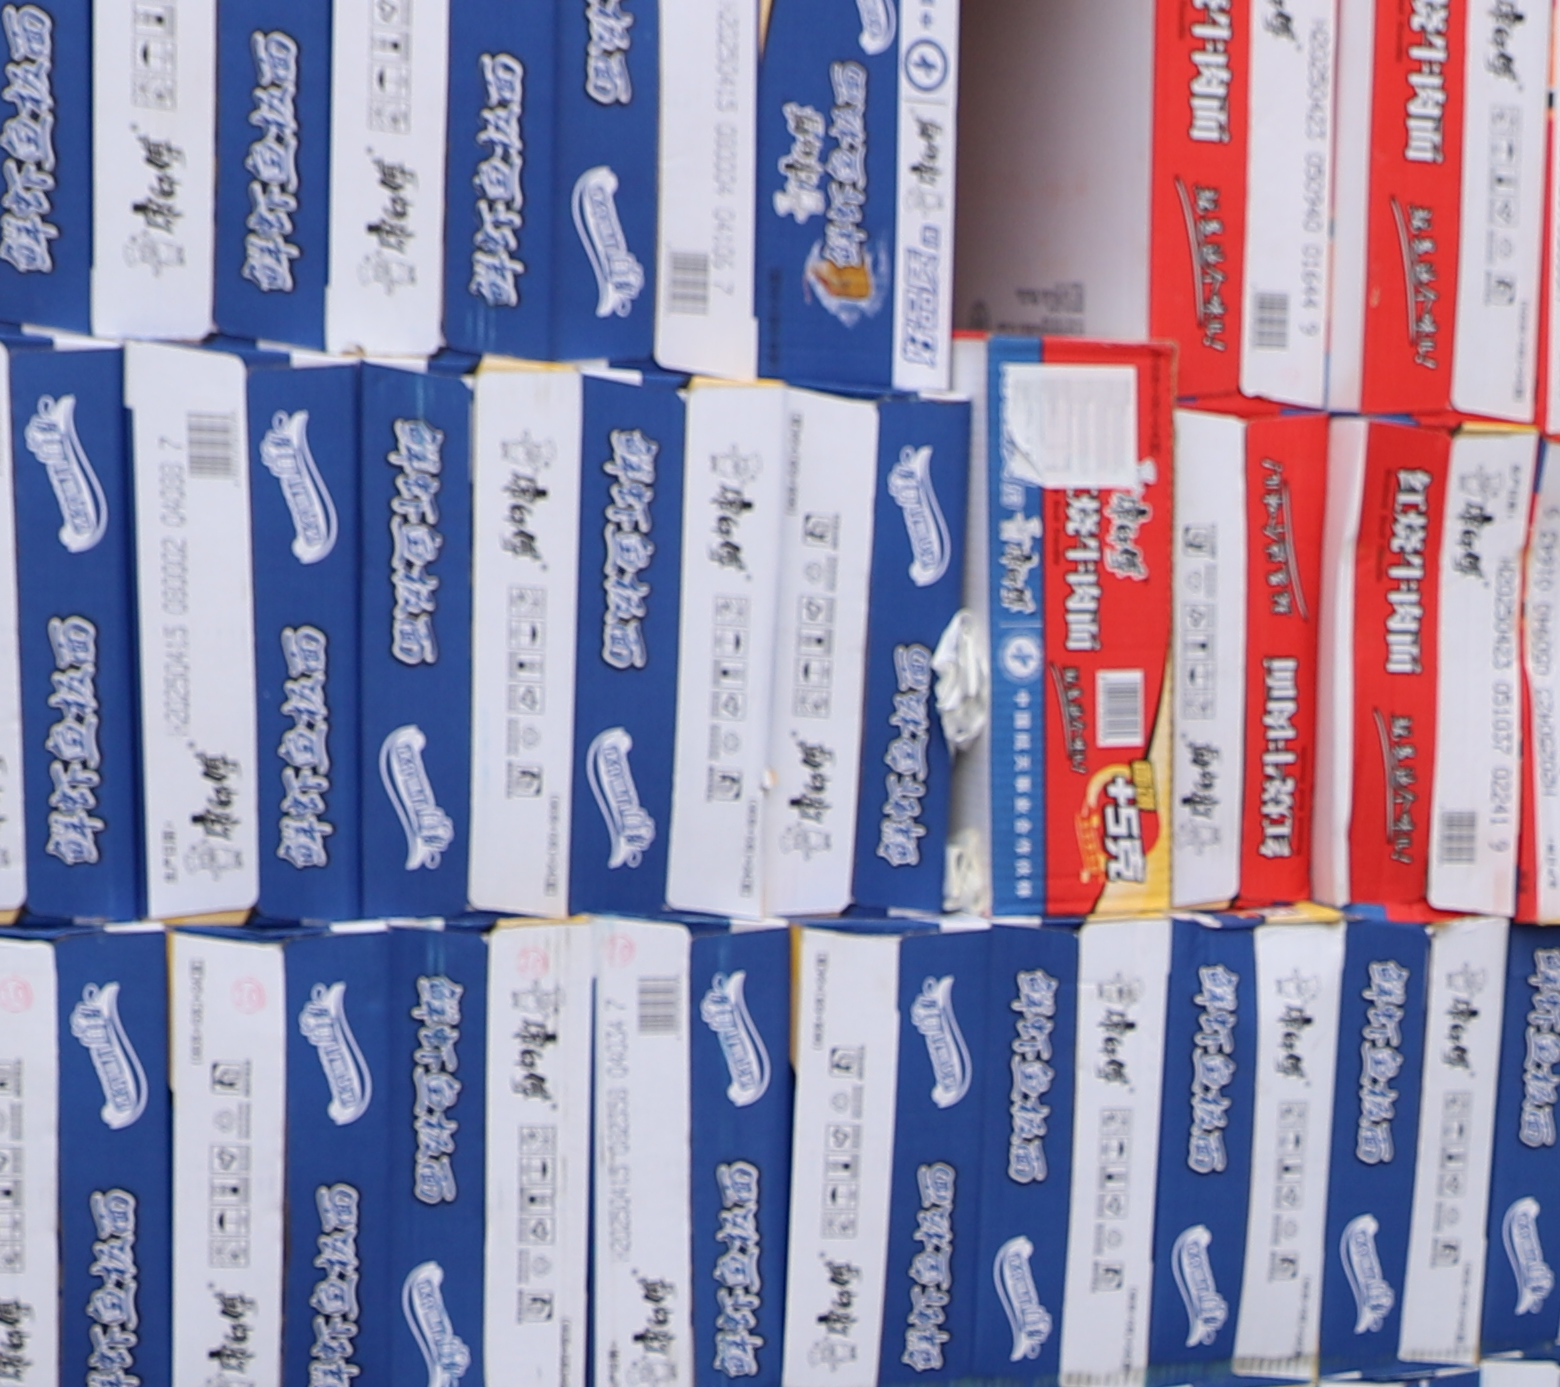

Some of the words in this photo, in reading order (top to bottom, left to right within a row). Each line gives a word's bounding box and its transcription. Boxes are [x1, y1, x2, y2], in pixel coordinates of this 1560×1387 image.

[243, 32, 299, 291] 鲜虾鱼板面
[470, 54, 524, 306] 鲜虾鱼板面
[388, 420, 443, 664] 鲜虾鱼板面
[603, 430, 658, 668] 鲜虾鱼板面
[1386, 469, 1432, 673] 红烧牛肉面
[46, 617, 104, 864] 鲜虾鱼板面
[278, 626, 332, 867] 鲜虾鱼板面
[1104, 775, 1145, 883] +5克
[1259, 658, 1298, 857] 红烧牛肉面
[412, 978, 463, 1203] 鲜虾鱼板面
[1009, 971, 1058, 1183] 鲜虾鱼板面
[1357, 962, 1408, 1163] 鲜虾鱼板面
[714, 1162, 763, 1376] 鲜虾鱼板面
